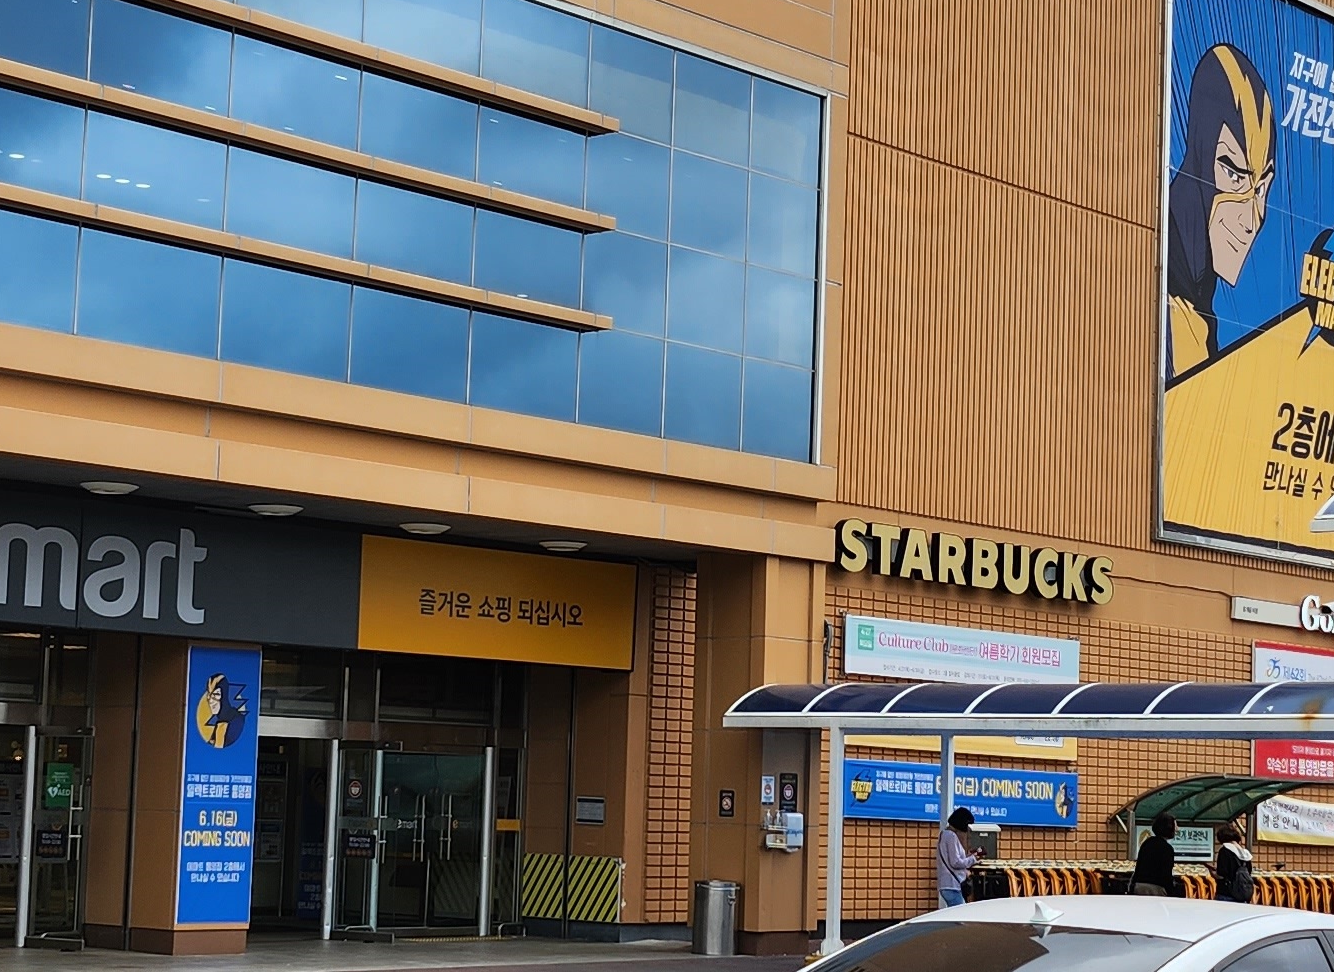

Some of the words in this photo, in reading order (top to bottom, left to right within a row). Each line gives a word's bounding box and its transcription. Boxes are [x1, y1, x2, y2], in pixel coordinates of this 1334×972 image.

[1290, 51, 1329, 90] 지구에
[1262, 460, 1308, 498] 만나실
[1311, 471, 1324, 500] 수
[837, 518, 1114, 605] STARBUCKS
[418, 588, 473, 619] 즐거운
[477, 595, 512, 623] 쇼핑
[517, 598, 584, 628] 되십시오
[878, 631, 922, 651] Culture
[923, 636, 949, 653] Club
[979, 641, 1020, 663] 여름학기
[1021, 646, 1061, 668] 회원모집
[981, 778, 1023, 799] COMING
[1024, 781, 1055, 800] SOON
[183, 830, 222, 847] COMING
[224, 830, 251, 847] SOON
